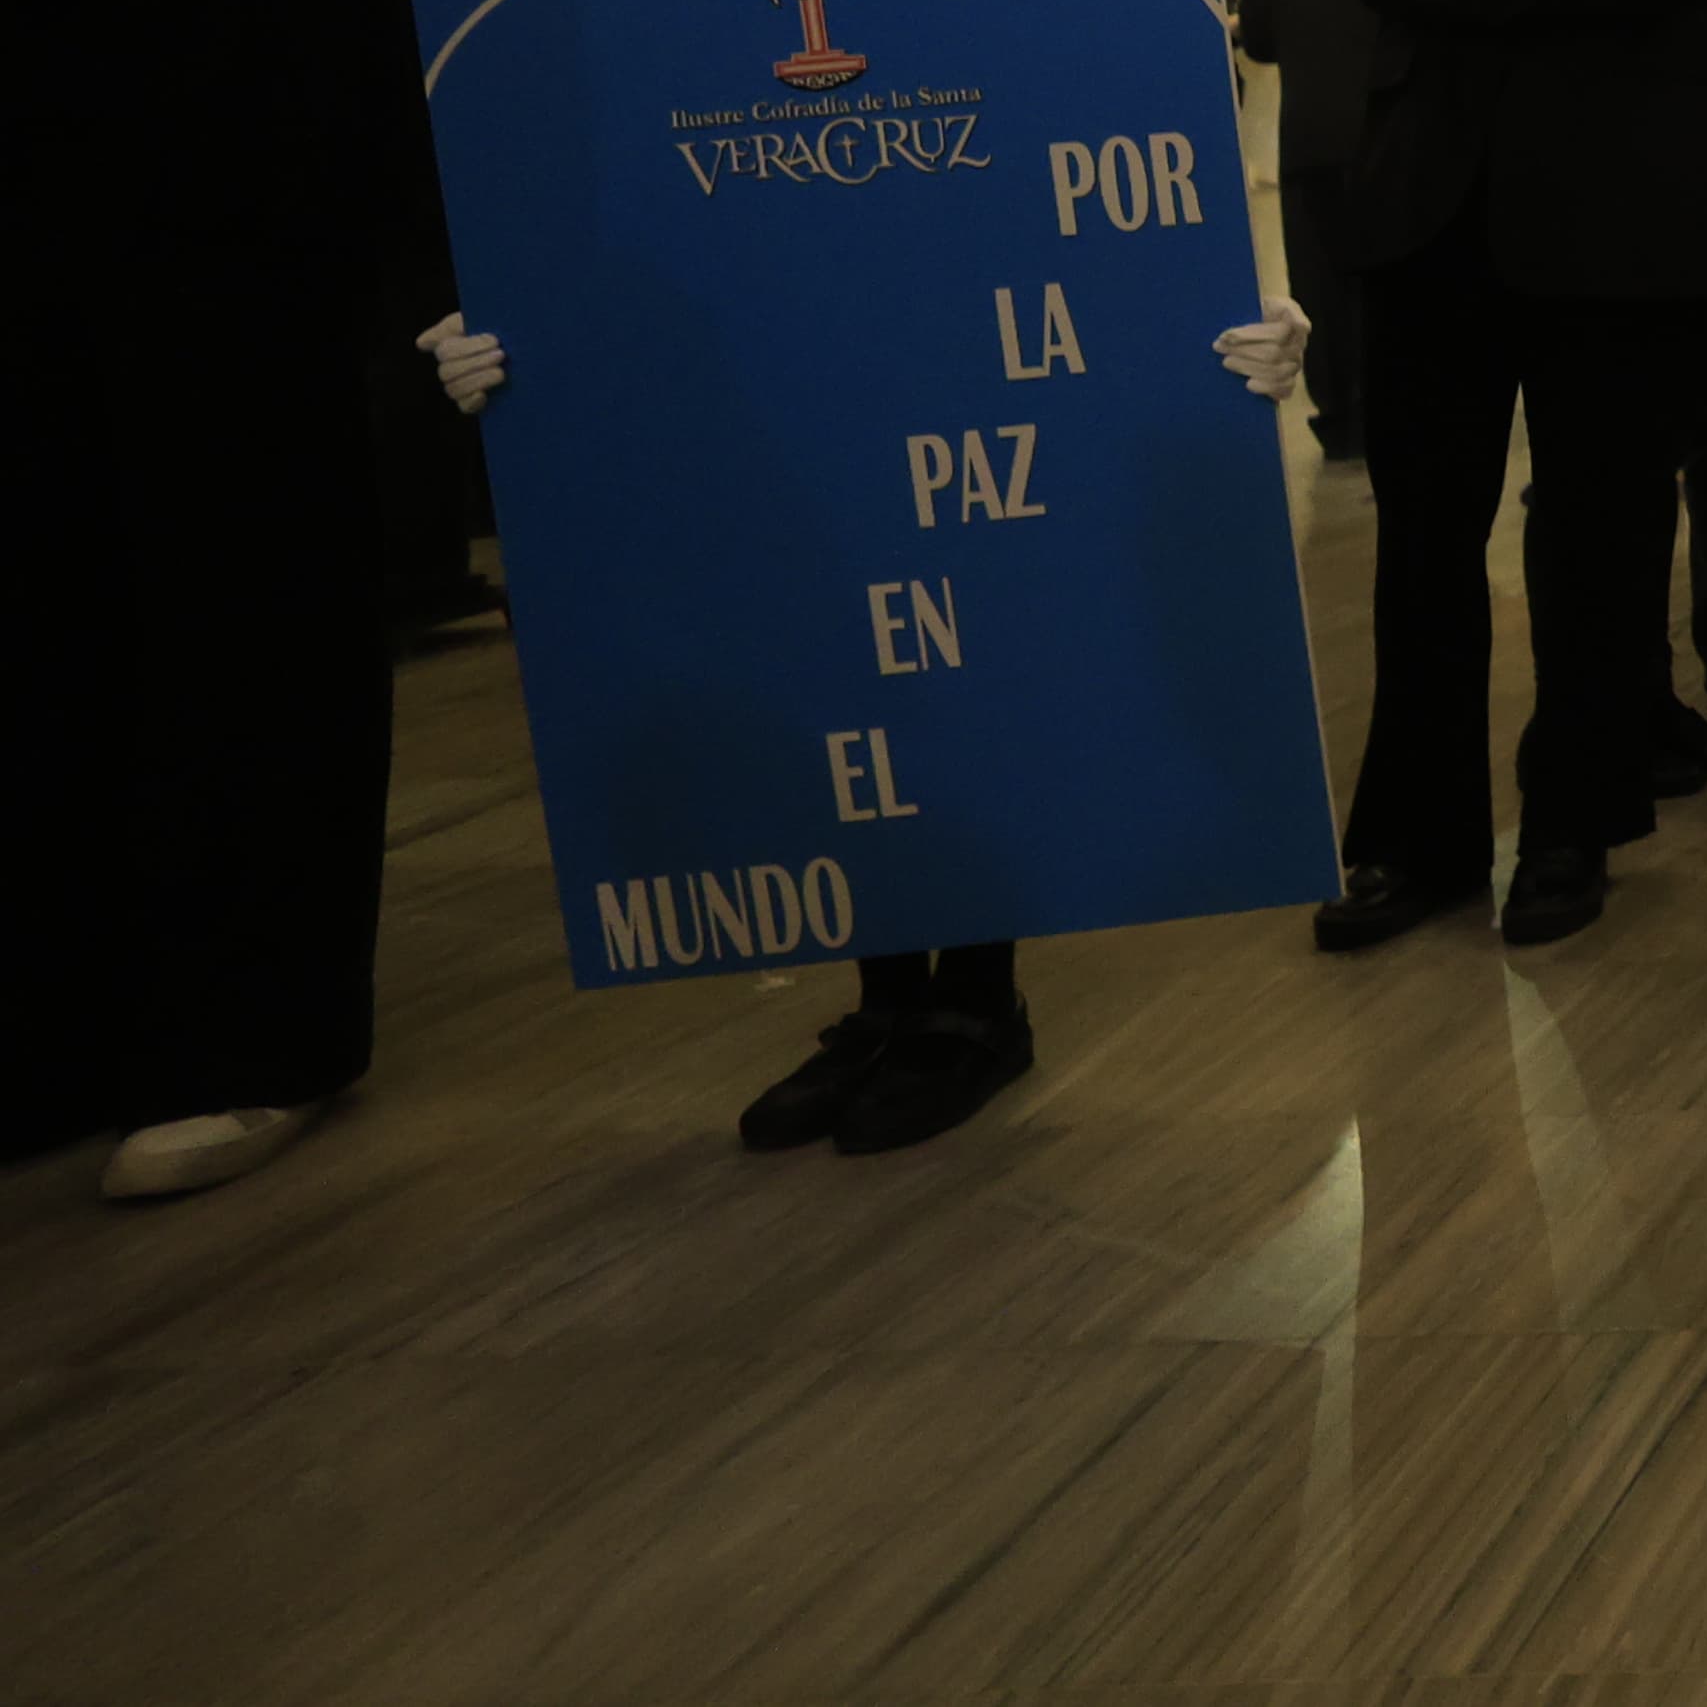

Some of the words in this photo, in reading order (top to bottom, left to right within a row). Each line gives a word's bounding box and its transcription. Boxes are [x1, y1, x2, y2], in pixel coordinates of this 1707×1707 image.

[671, 109, 745, 129] Ilustre
[751, 95, 850, 122] Cofradía
[858, 95, 883, 112] de
[891, 90, 912, 109] la
[917, 85, 983, 105] Santa
[1048, 132, 1203, 236] POR
[994, 282, 1087, 381] LA
[906, 424, 1047, 528] PAZ
[867, 577, 962, 675] EN
[825, 727, 919, 823] EL
[596, 857, 854, 972] MUNDO
